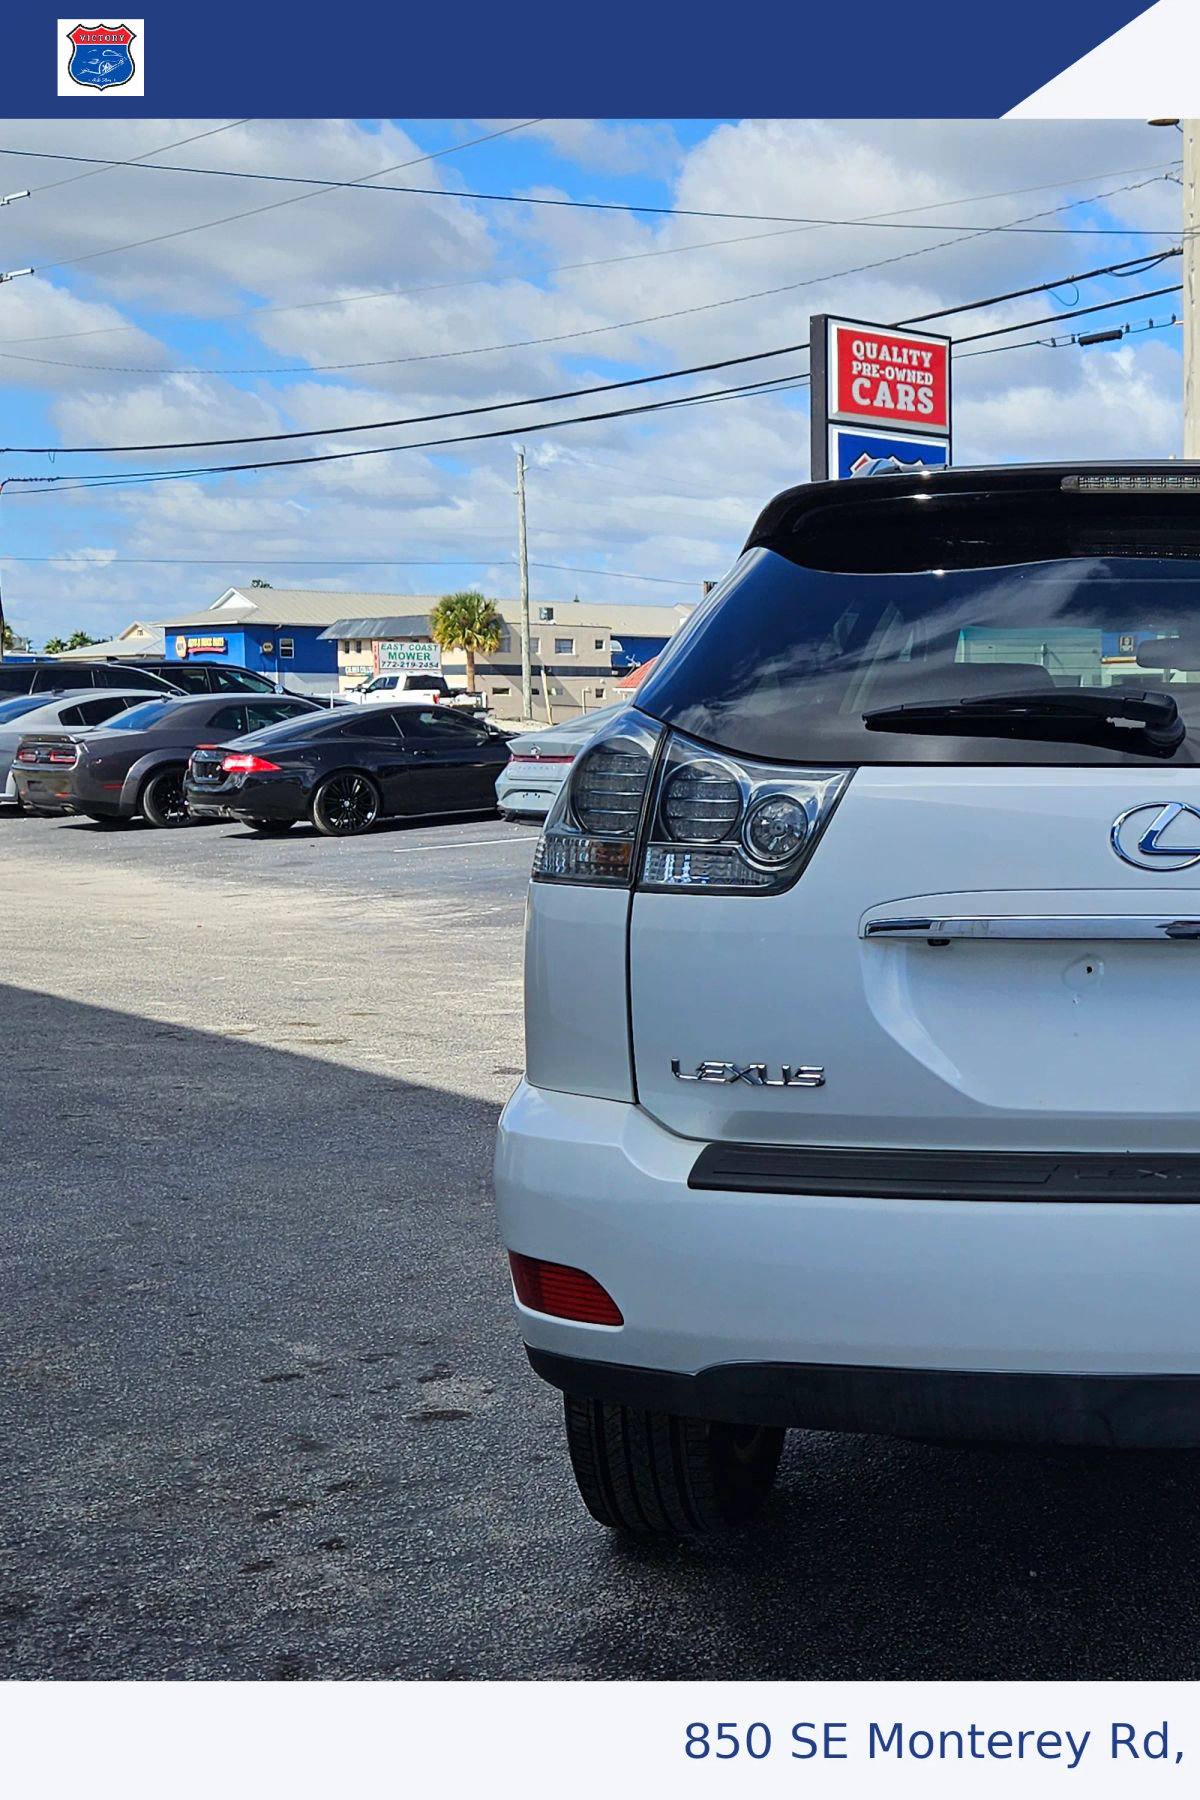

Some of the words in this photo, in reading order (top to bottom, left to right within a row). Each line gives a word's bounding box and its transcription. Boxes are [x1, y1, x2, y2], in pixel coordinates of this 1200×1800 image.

[851, 340, 933, 369] QUALITY
[851, 360, 933, 386] PRE-OWNED
[851, 377, 935, 415] CARS
[388, 652, 431, 661] MOWER
[671, 1058, 826, 1088] LEXUS
